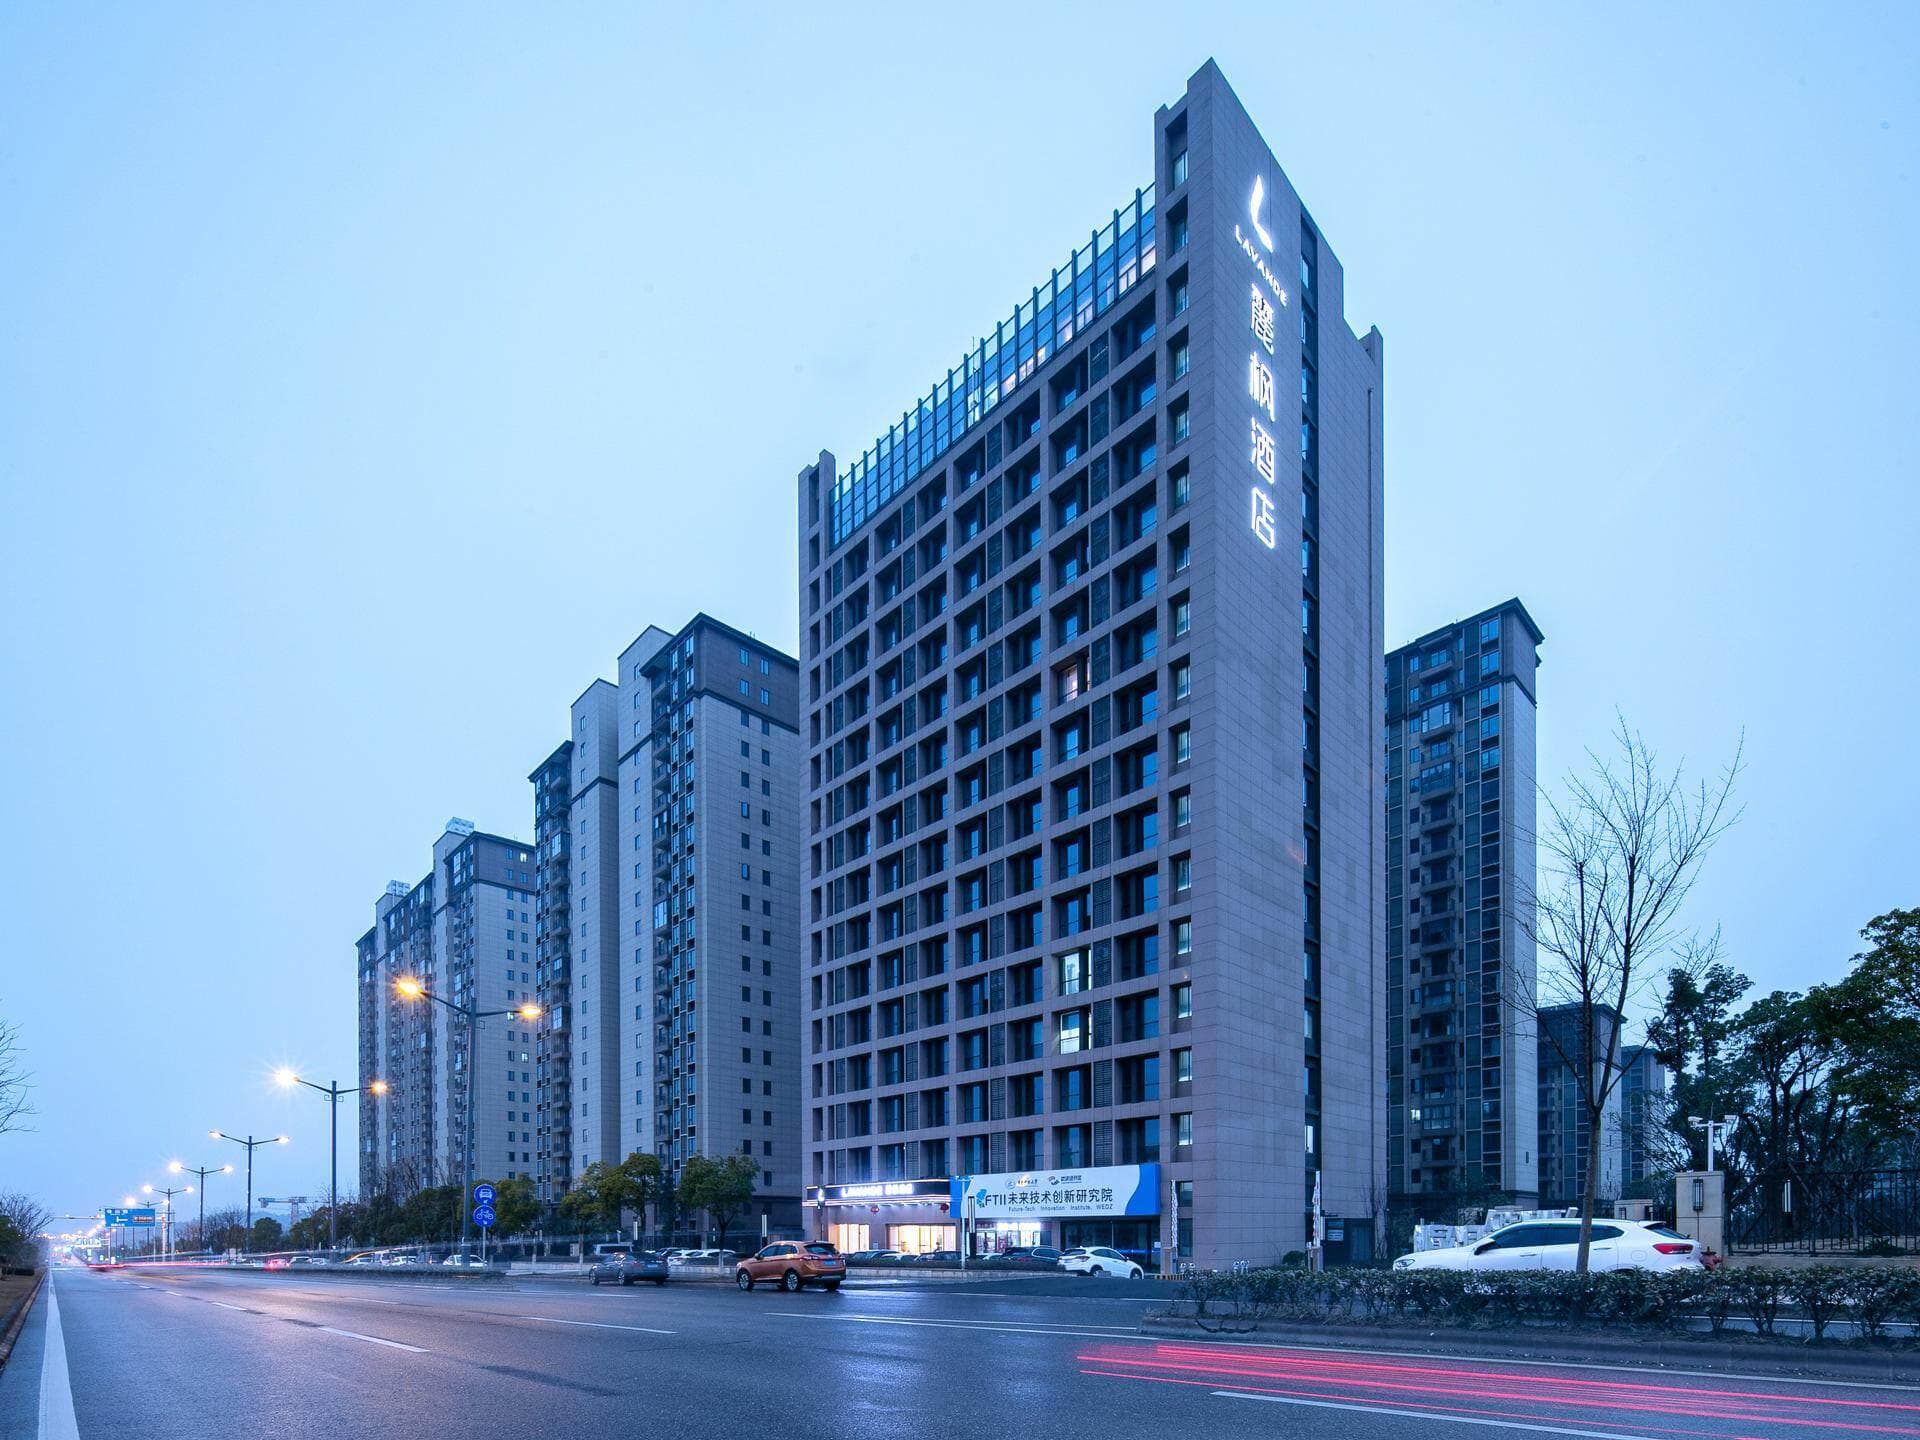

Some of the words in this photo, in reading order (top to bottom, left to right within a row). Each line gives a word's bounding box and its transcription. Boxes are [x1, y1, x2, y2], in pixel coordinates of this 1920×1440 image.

[1235, 223, 1287, 307] LAVANDE
[1008, 1188, 1113, 1205] 未来技术创新研究院
